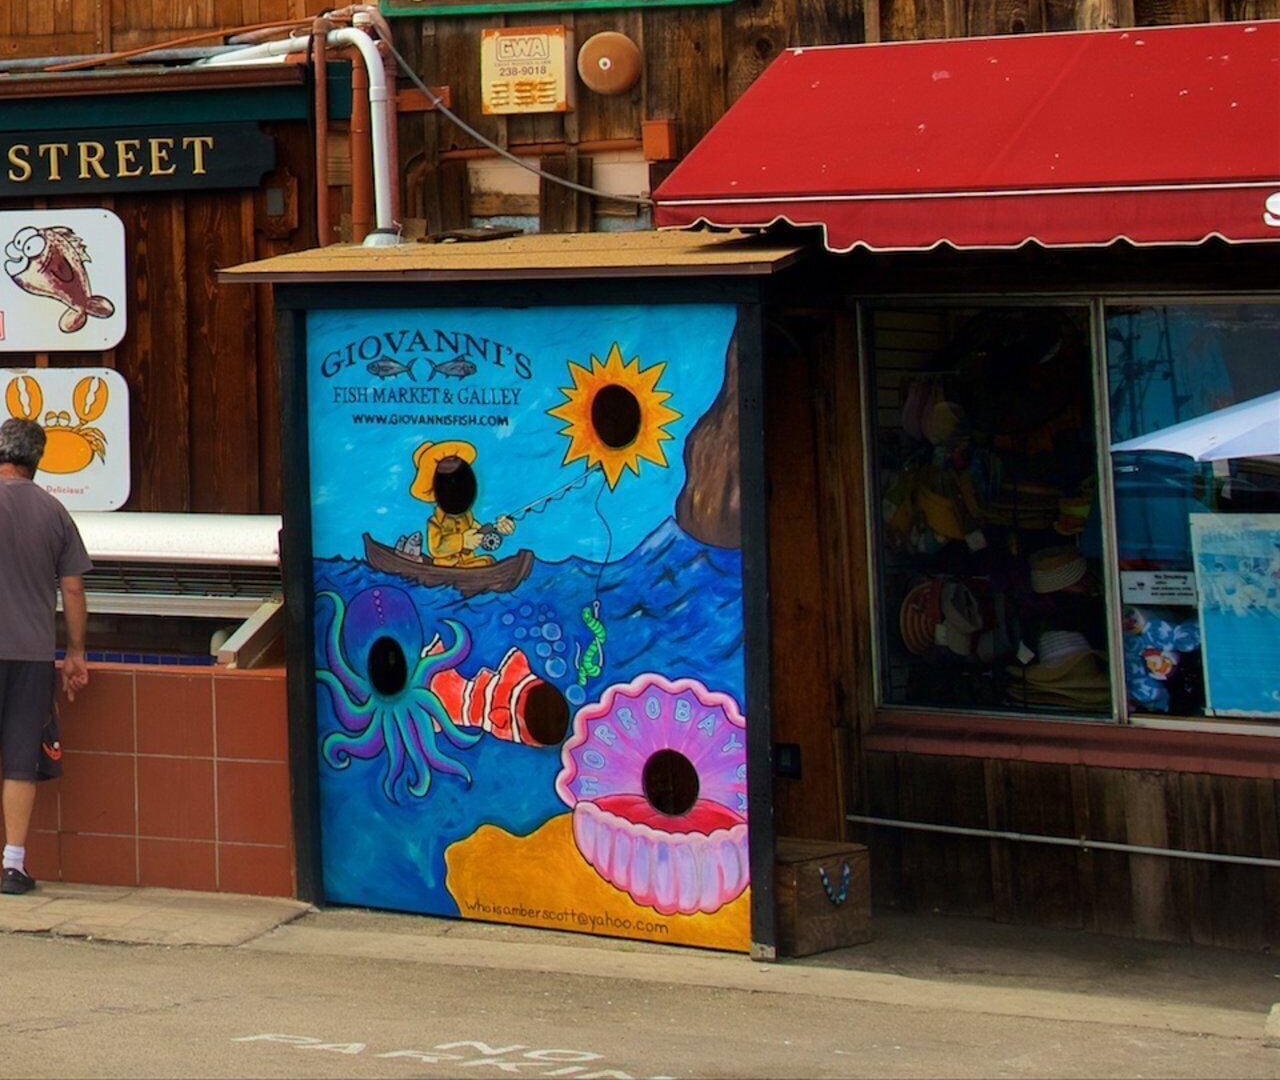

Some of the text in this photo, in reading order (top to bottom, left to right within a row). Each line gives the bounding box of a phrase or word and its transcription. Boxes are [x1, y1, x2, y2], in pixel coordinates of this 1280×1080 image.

[500, 37, 545, 58] GWA
[500, 65, 546, 76] 238-9018
[8, 136, 214, 182] STREET
[321, 329, 532, 379] GIOVANNI'S
[333, 387, 522, 404] FISH MARKET & GALLEY
